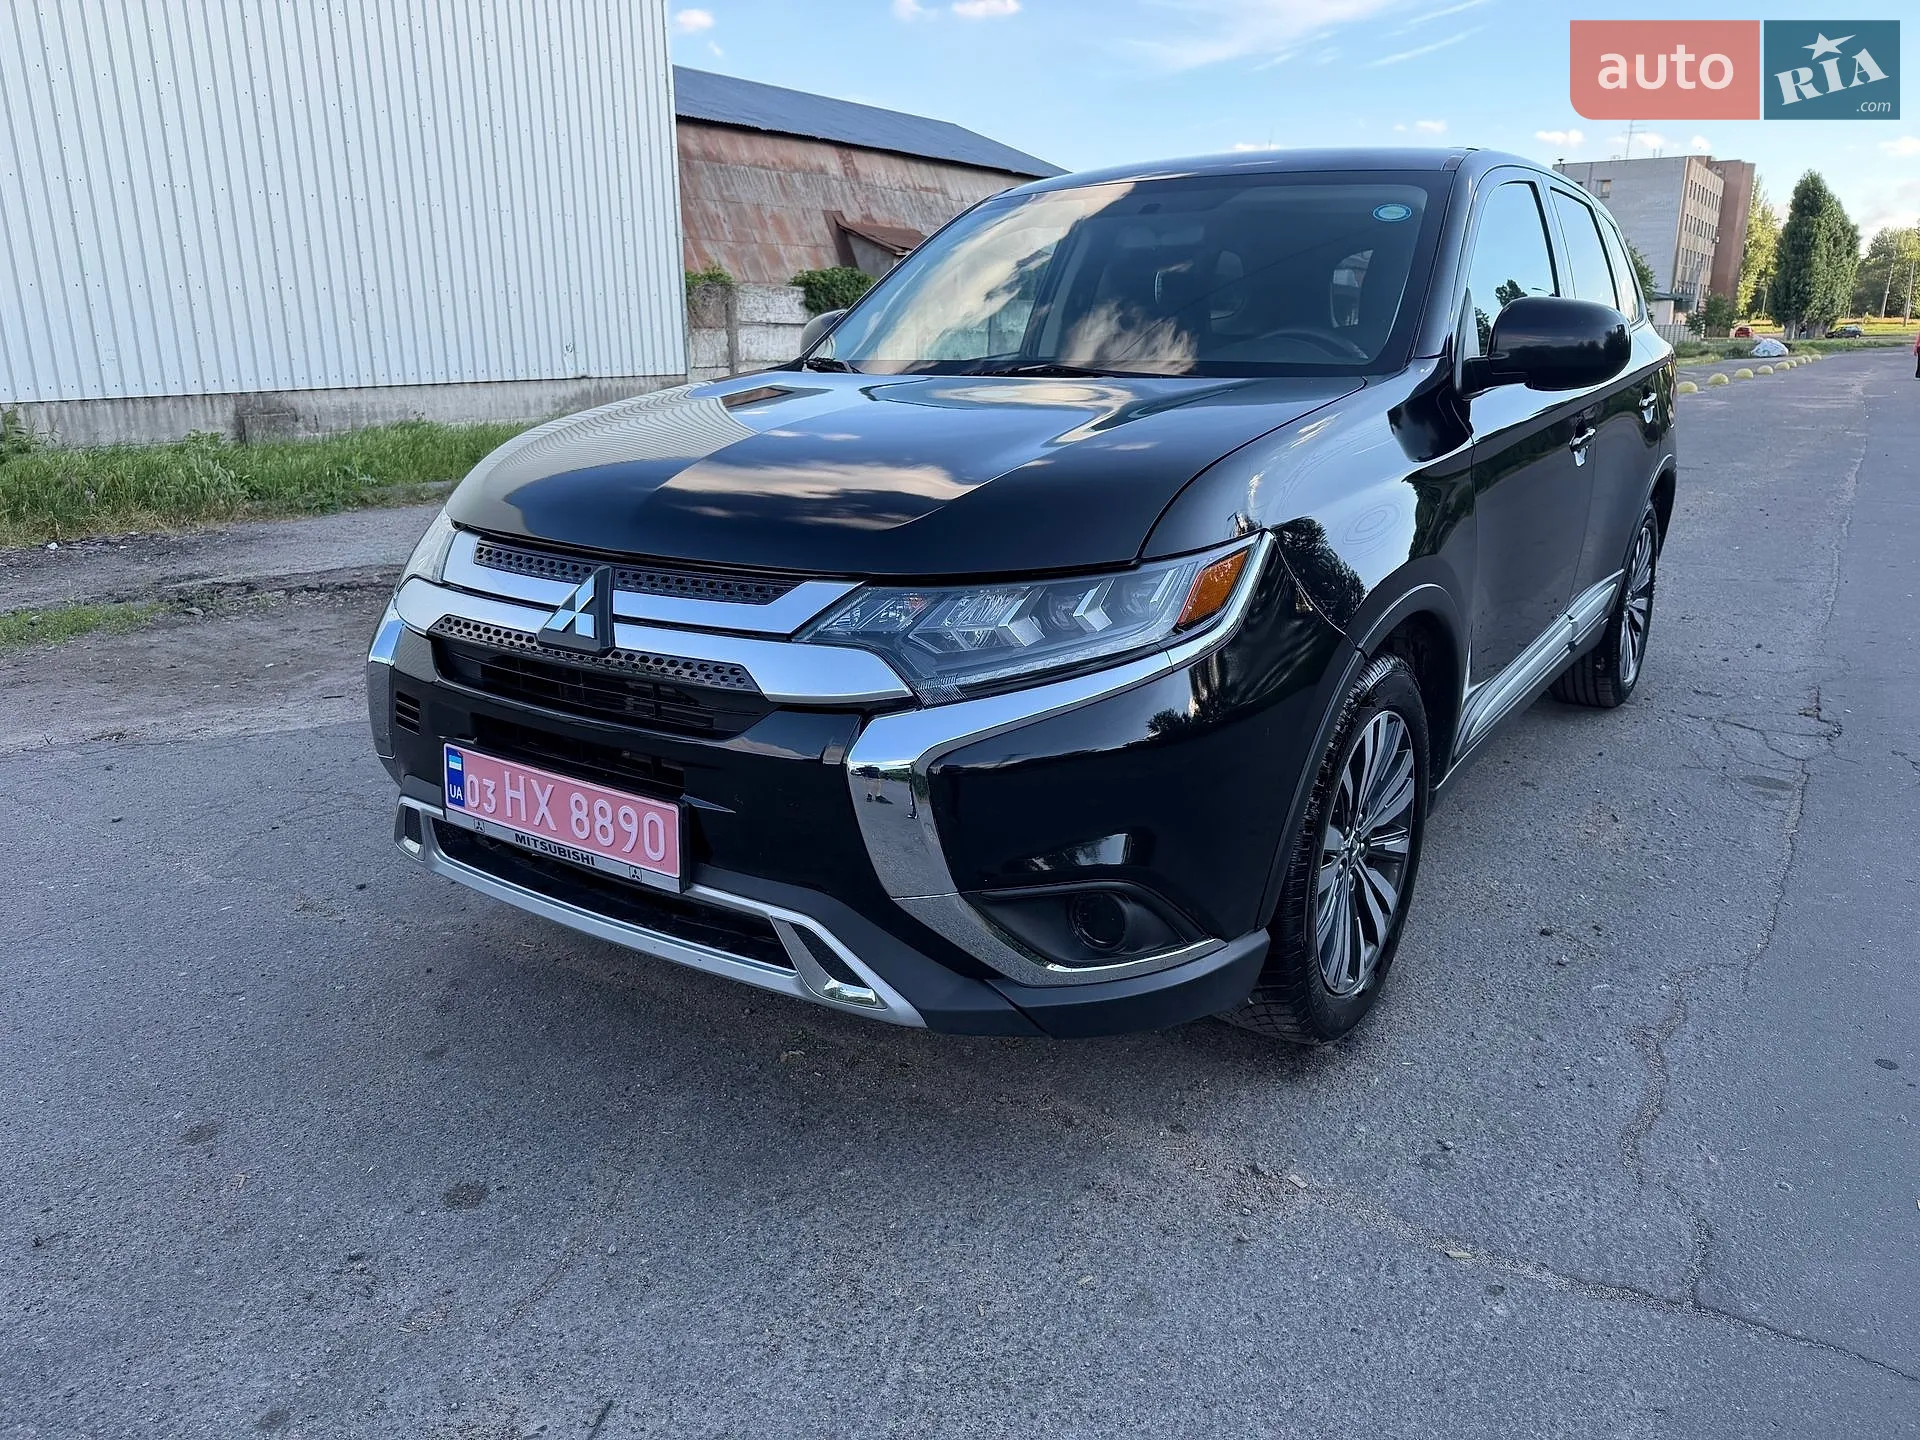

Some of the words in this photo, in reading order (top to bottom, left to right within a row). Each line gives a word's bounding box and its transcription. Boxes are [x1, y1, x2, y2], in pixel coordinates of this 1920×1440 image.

[449, 783, 464, 801] UA
[466, 773, 497, 814] 03
[504, 770, 557, 831] HX
[569, 791, 665, 863] 8890
[514, 832, 596, 866] MITSUBISHI
